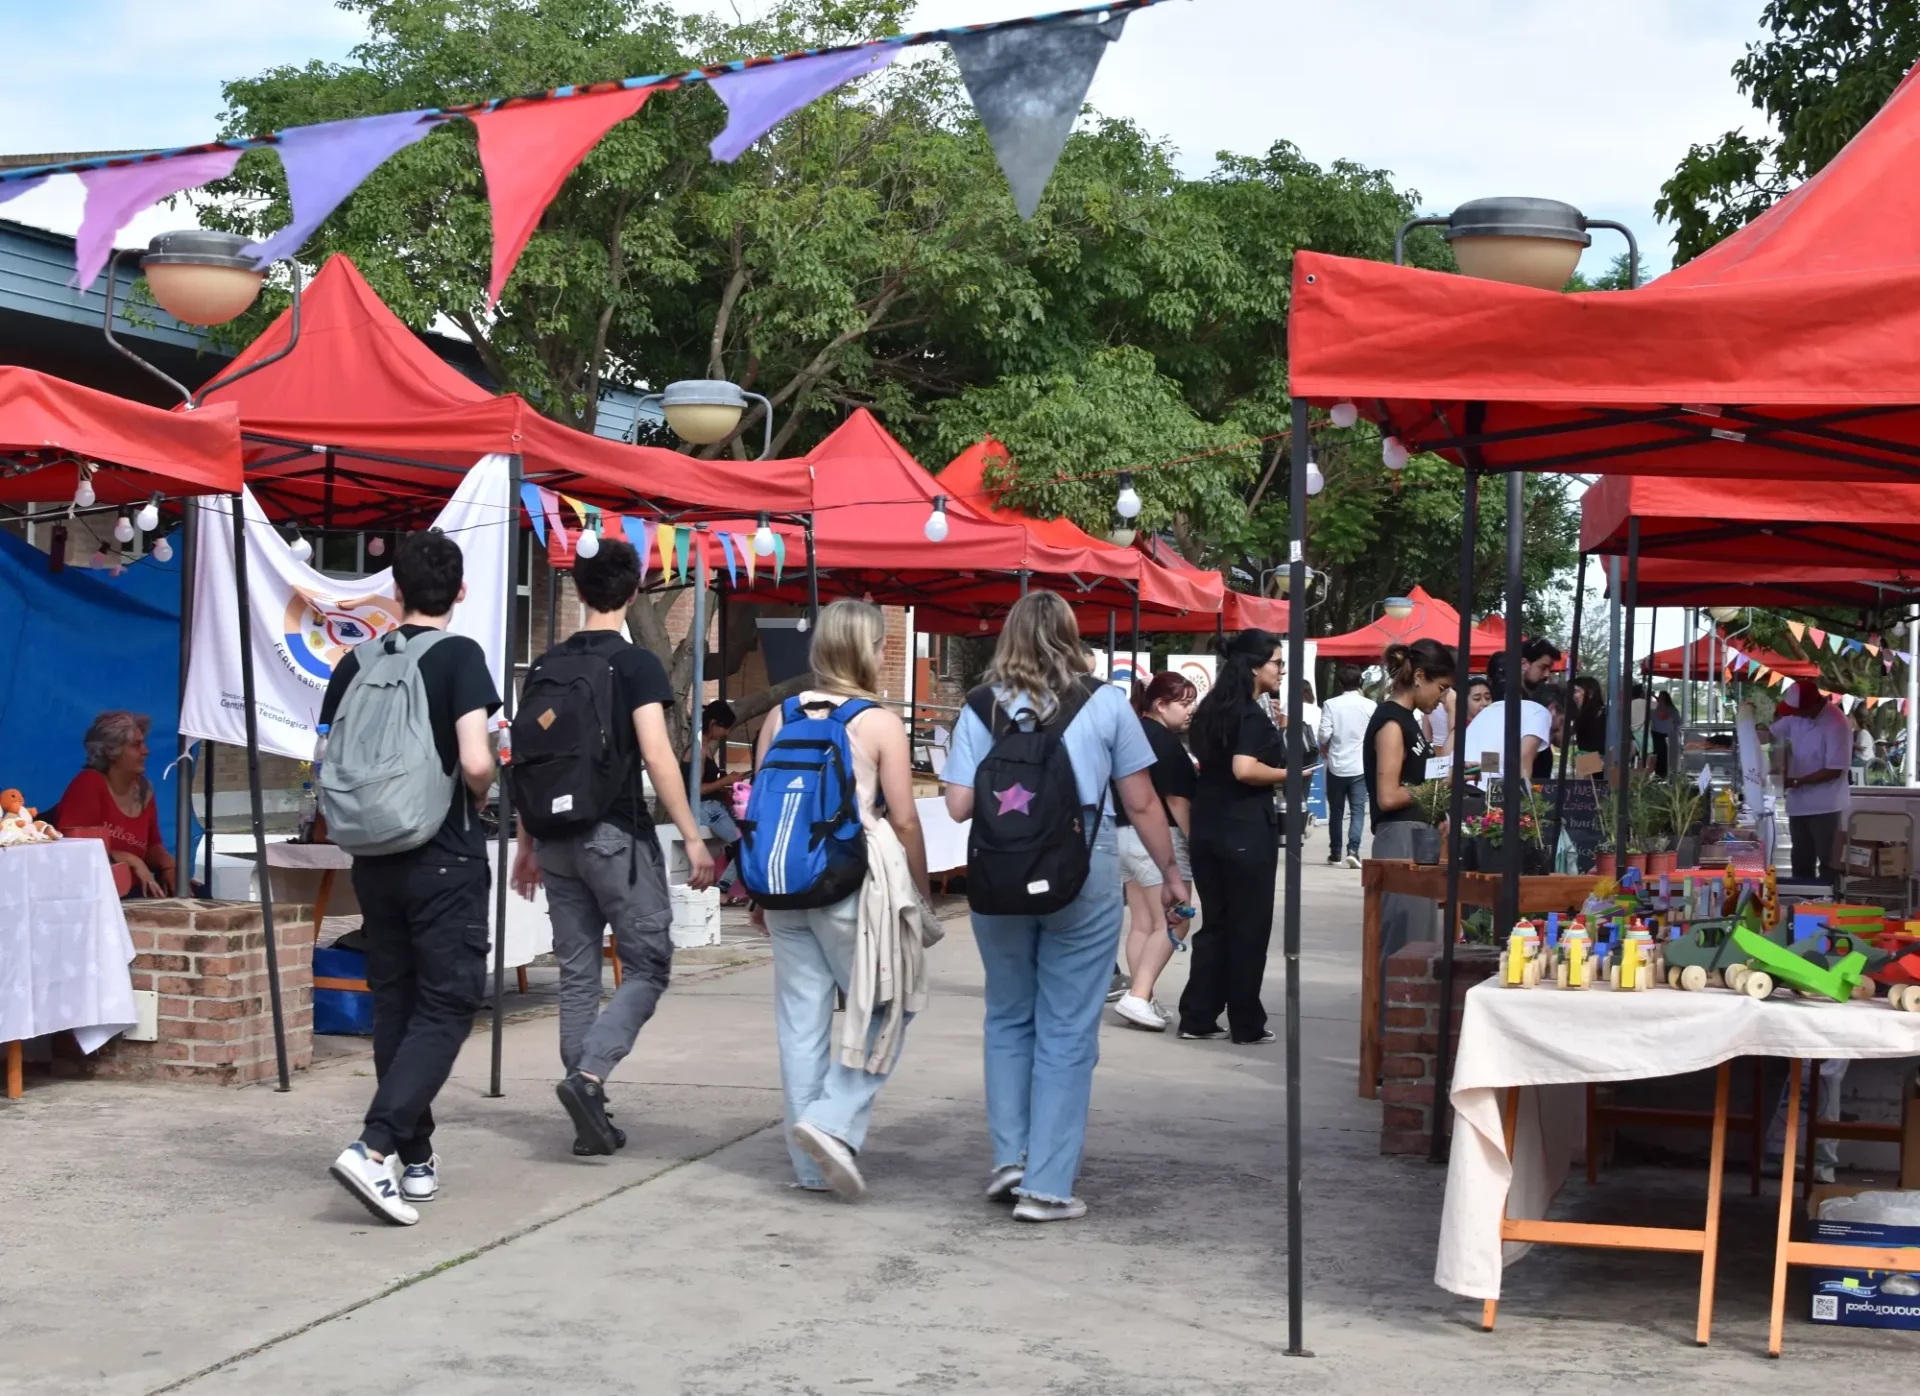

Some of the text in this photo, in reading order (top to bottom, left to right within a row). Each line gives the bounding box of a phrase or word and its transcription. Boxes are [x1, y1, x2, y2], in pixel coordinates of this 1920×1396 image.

[274, 642, 296, 675] FERIA
[259, 707, 308, 731] Tecnológica
[374, 1179, 397, 1199] N
[1845, 1300, 1920, 1316] ananaTropical
